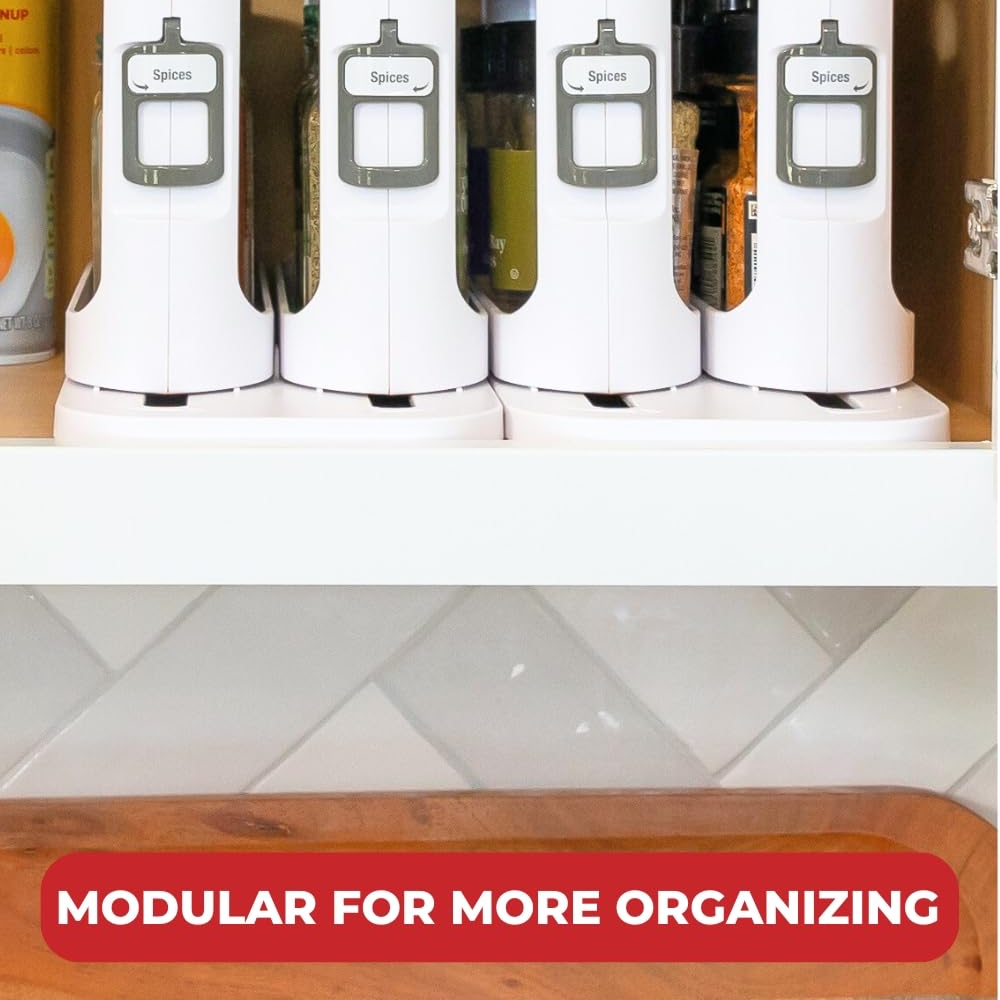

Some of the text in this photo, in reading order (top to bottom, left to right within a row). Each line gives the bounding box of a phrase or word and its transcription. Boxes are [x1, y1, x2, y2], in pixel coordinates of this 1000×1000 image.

[153, 67, 192, 82] Spices
[370, 69, 409, 84] Spices
[588, 69, 627, 85] Spices
[811, 70, 850, 85] Spices
